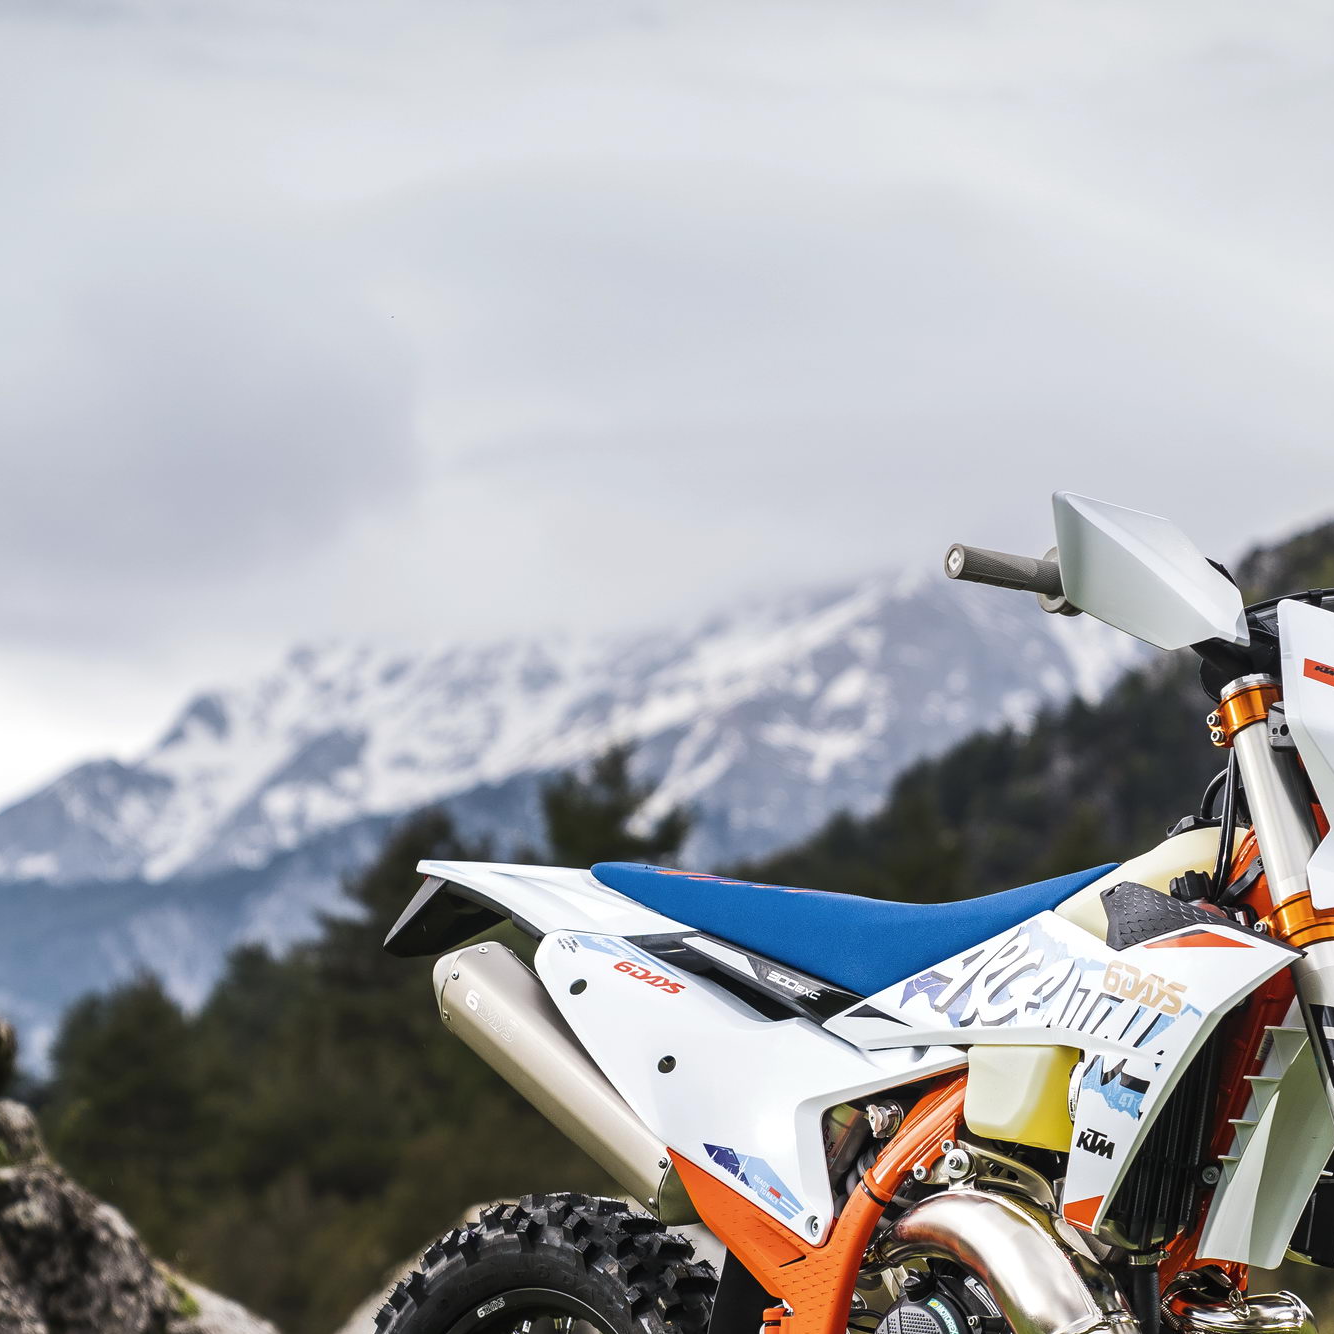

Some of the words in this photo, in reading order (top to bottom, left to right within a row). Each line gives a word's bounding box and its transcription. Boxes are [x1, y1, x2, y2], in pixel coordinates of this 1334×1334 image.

[612, 961, 687, 994] 6DAYS
[1101, 959, 1188, 1016] 6DAYS
[1076, 1127, 1116, 1160] KTM
